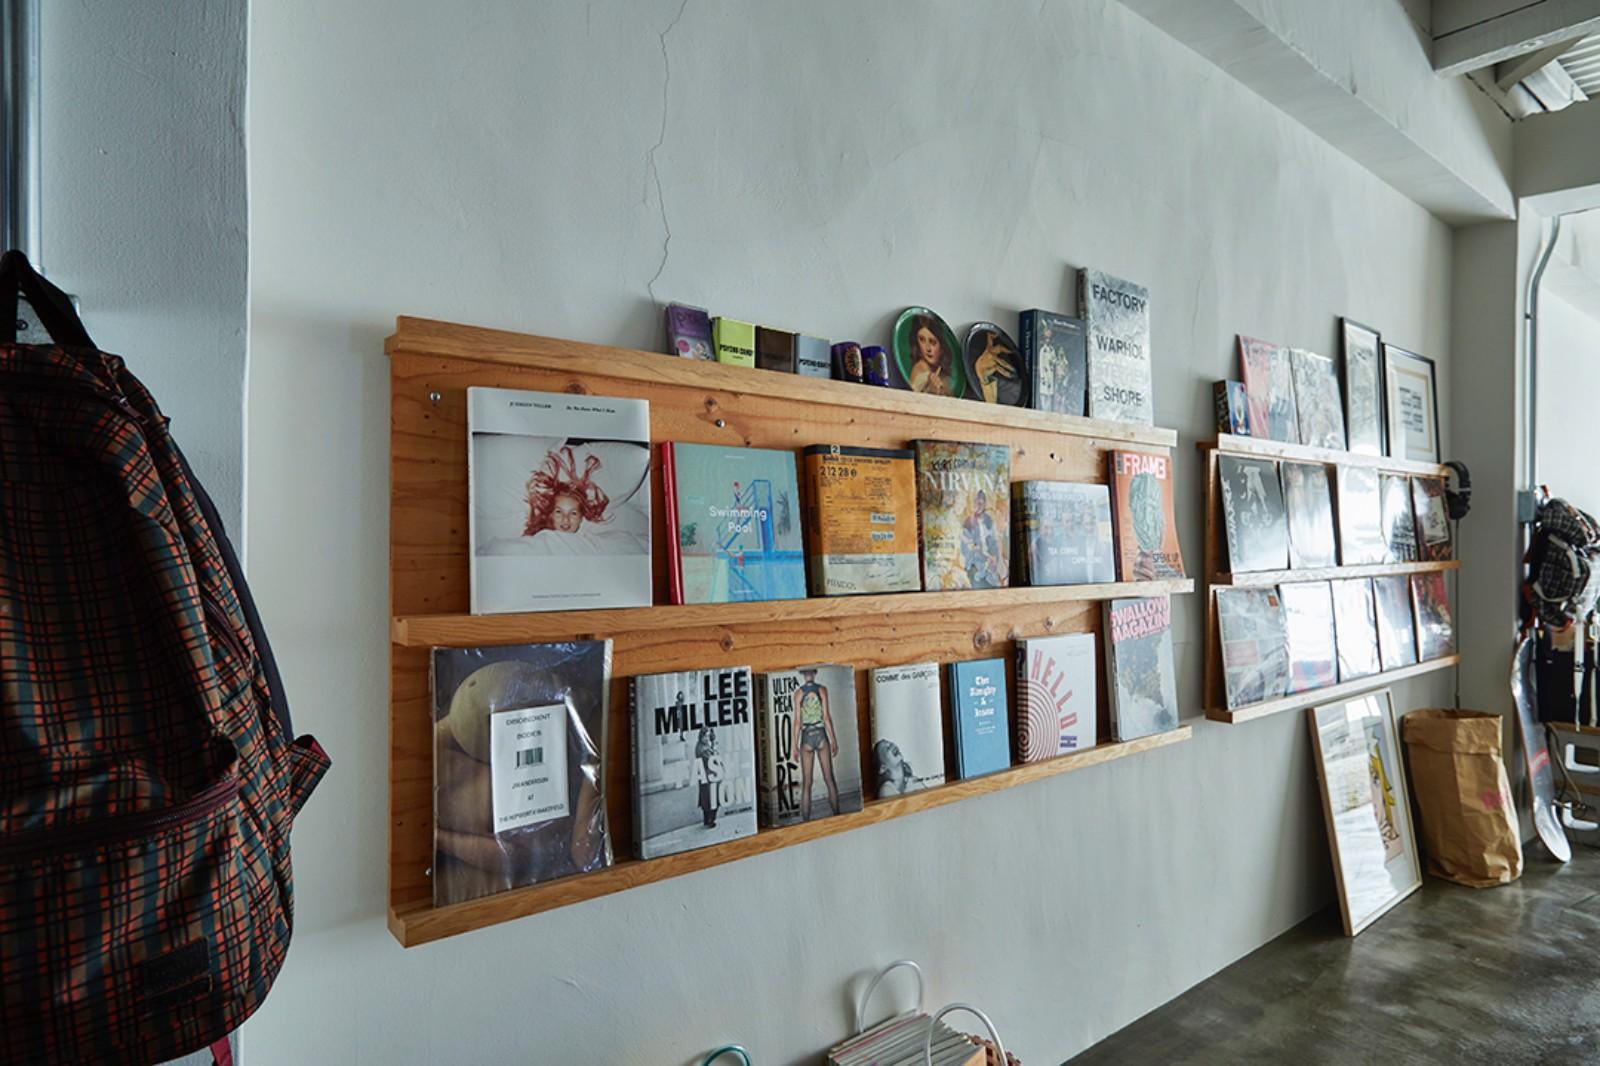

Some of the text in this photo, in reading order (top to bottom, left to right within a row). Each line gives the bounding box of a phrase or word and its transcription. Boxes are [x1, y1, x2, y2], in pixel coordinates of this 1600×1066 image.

[1092, 284, 1147, 313] FACTORY
[1095, 334, 1145, 361] WARHOL
[1103, 385, 1143, 408] SHORE
[832, 445, 839, 453] 2
[925, 470, 1007, 494] NIRVANA
[709, 505, 767, 521] Swimming
[728, 521, 753, 533] Pool
[704, 670, 748, 701] LEE
[772, 676, 800, 696] ULTRA
[876, 674, 900, 683] COMME
[1031, 648, 1078, 730] HELLO
[773, 695, 793, 713] MEGA
[655, 698, 749, 736] MILLER
[775, 713, 792, 763] LO
[710, 777, 751, 809] ION
[776, 762, 800, 813] RE
